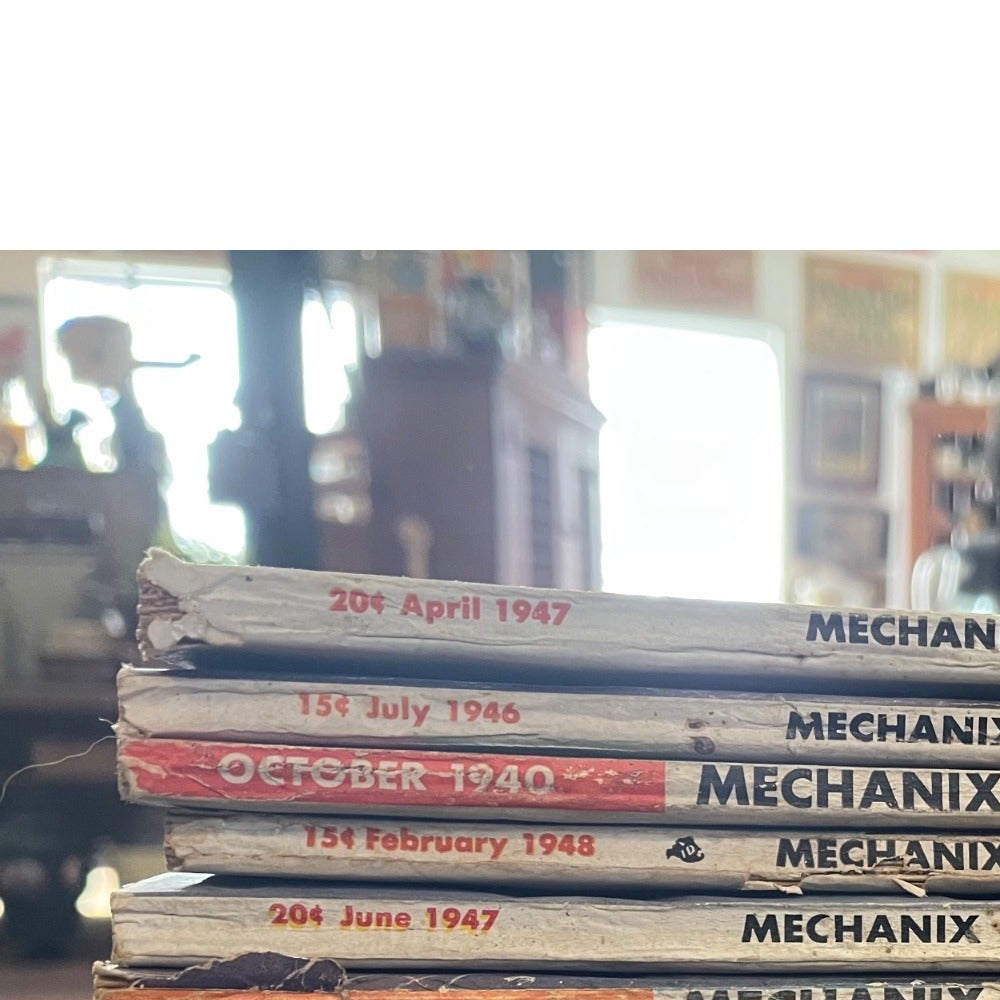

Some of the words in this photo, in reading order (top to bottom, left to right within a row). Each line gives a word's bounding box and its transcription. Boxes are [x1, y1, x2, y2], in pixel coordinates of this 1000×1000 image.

[329, 587, 385, 613] 20¢
[402, 591, 480, 625] April
[496, 598, 571, 626] 1947
[299, 692, 349, 718] 15¢
[366, 696, 431, 727] July
[448, 700, 521, 724] 1946
[217, 753, 427, 792] OCTOBER
[450, 763, 555, 796] 1940
[305, 826, 356, 850] 15¢
[365, 828, 507, 860] February
[523, 834, 596, 857] 1948
[268, 903, 323, 928] 20¢
[340, 906, 412, 930] June
[425, 908, 500, 933] 1947
[741, 912, 980, 944] MECHANIX
